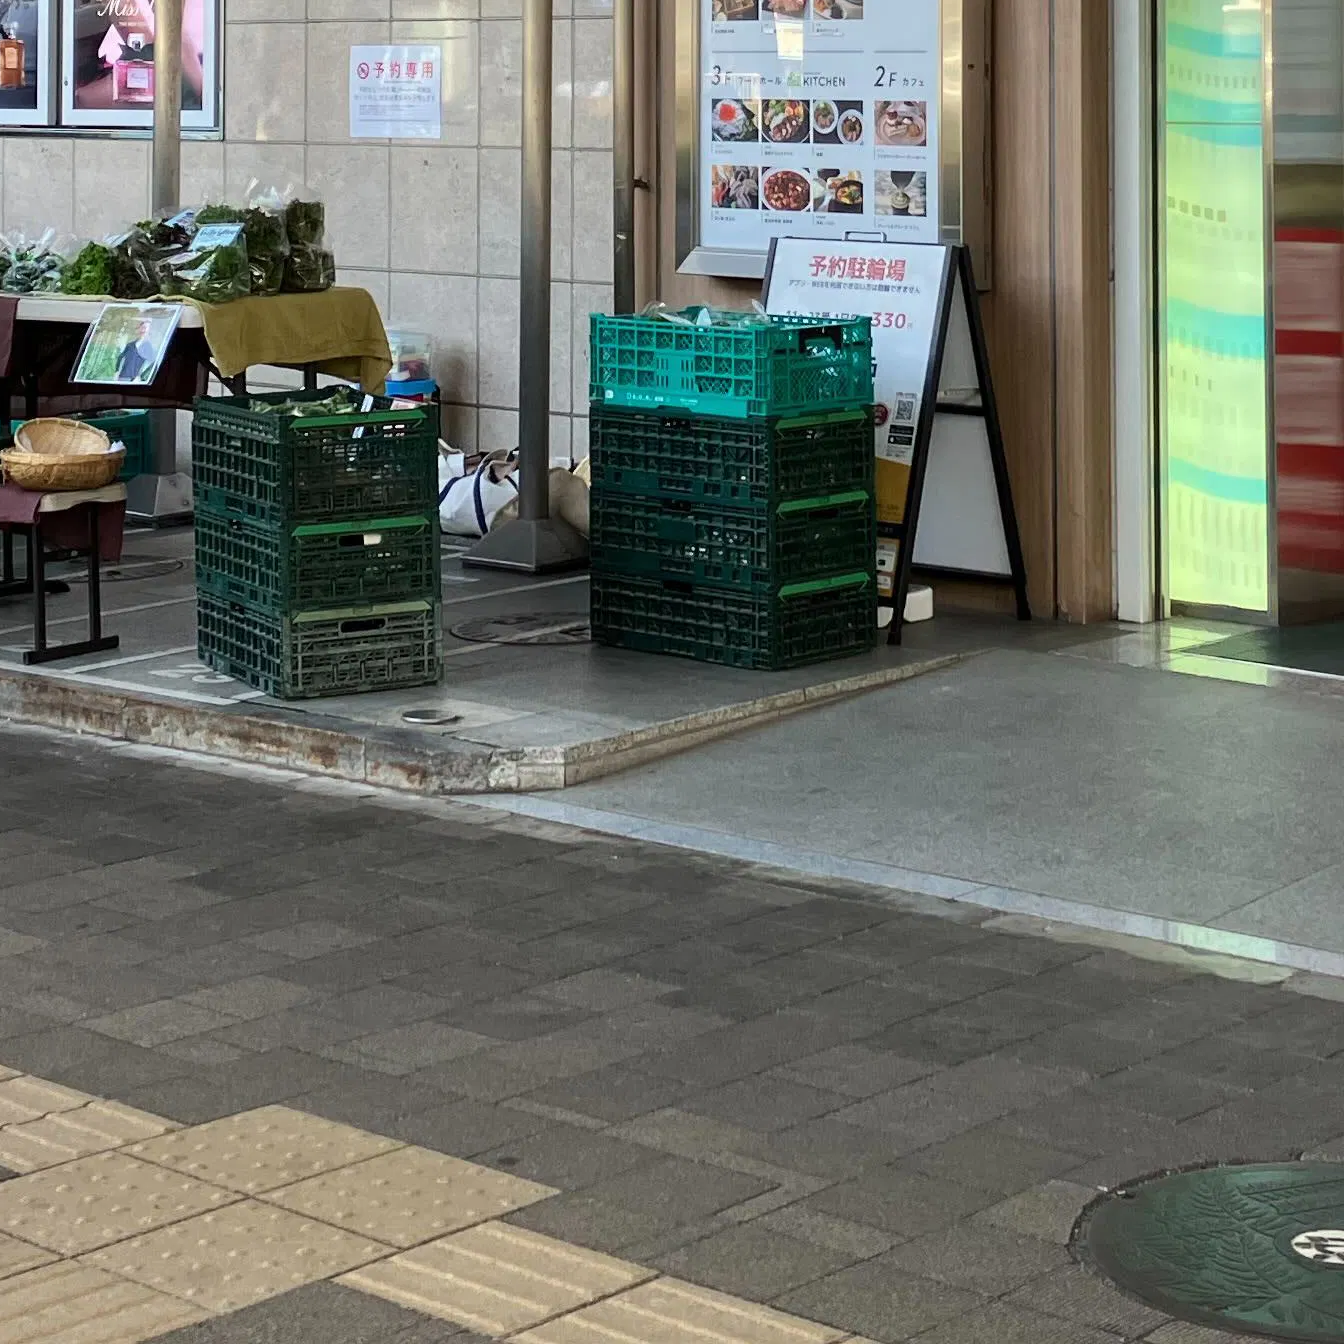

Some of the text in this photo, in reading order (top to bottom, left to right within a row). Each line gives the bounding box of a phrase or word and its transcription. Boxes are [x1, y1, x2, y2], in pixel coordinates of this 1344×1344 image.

[804, 76, 846, 87] KITCHEN
[874, 66, 925, 87] 2F カフェ
[809, 256, 906, 282] 予約駐輪場
